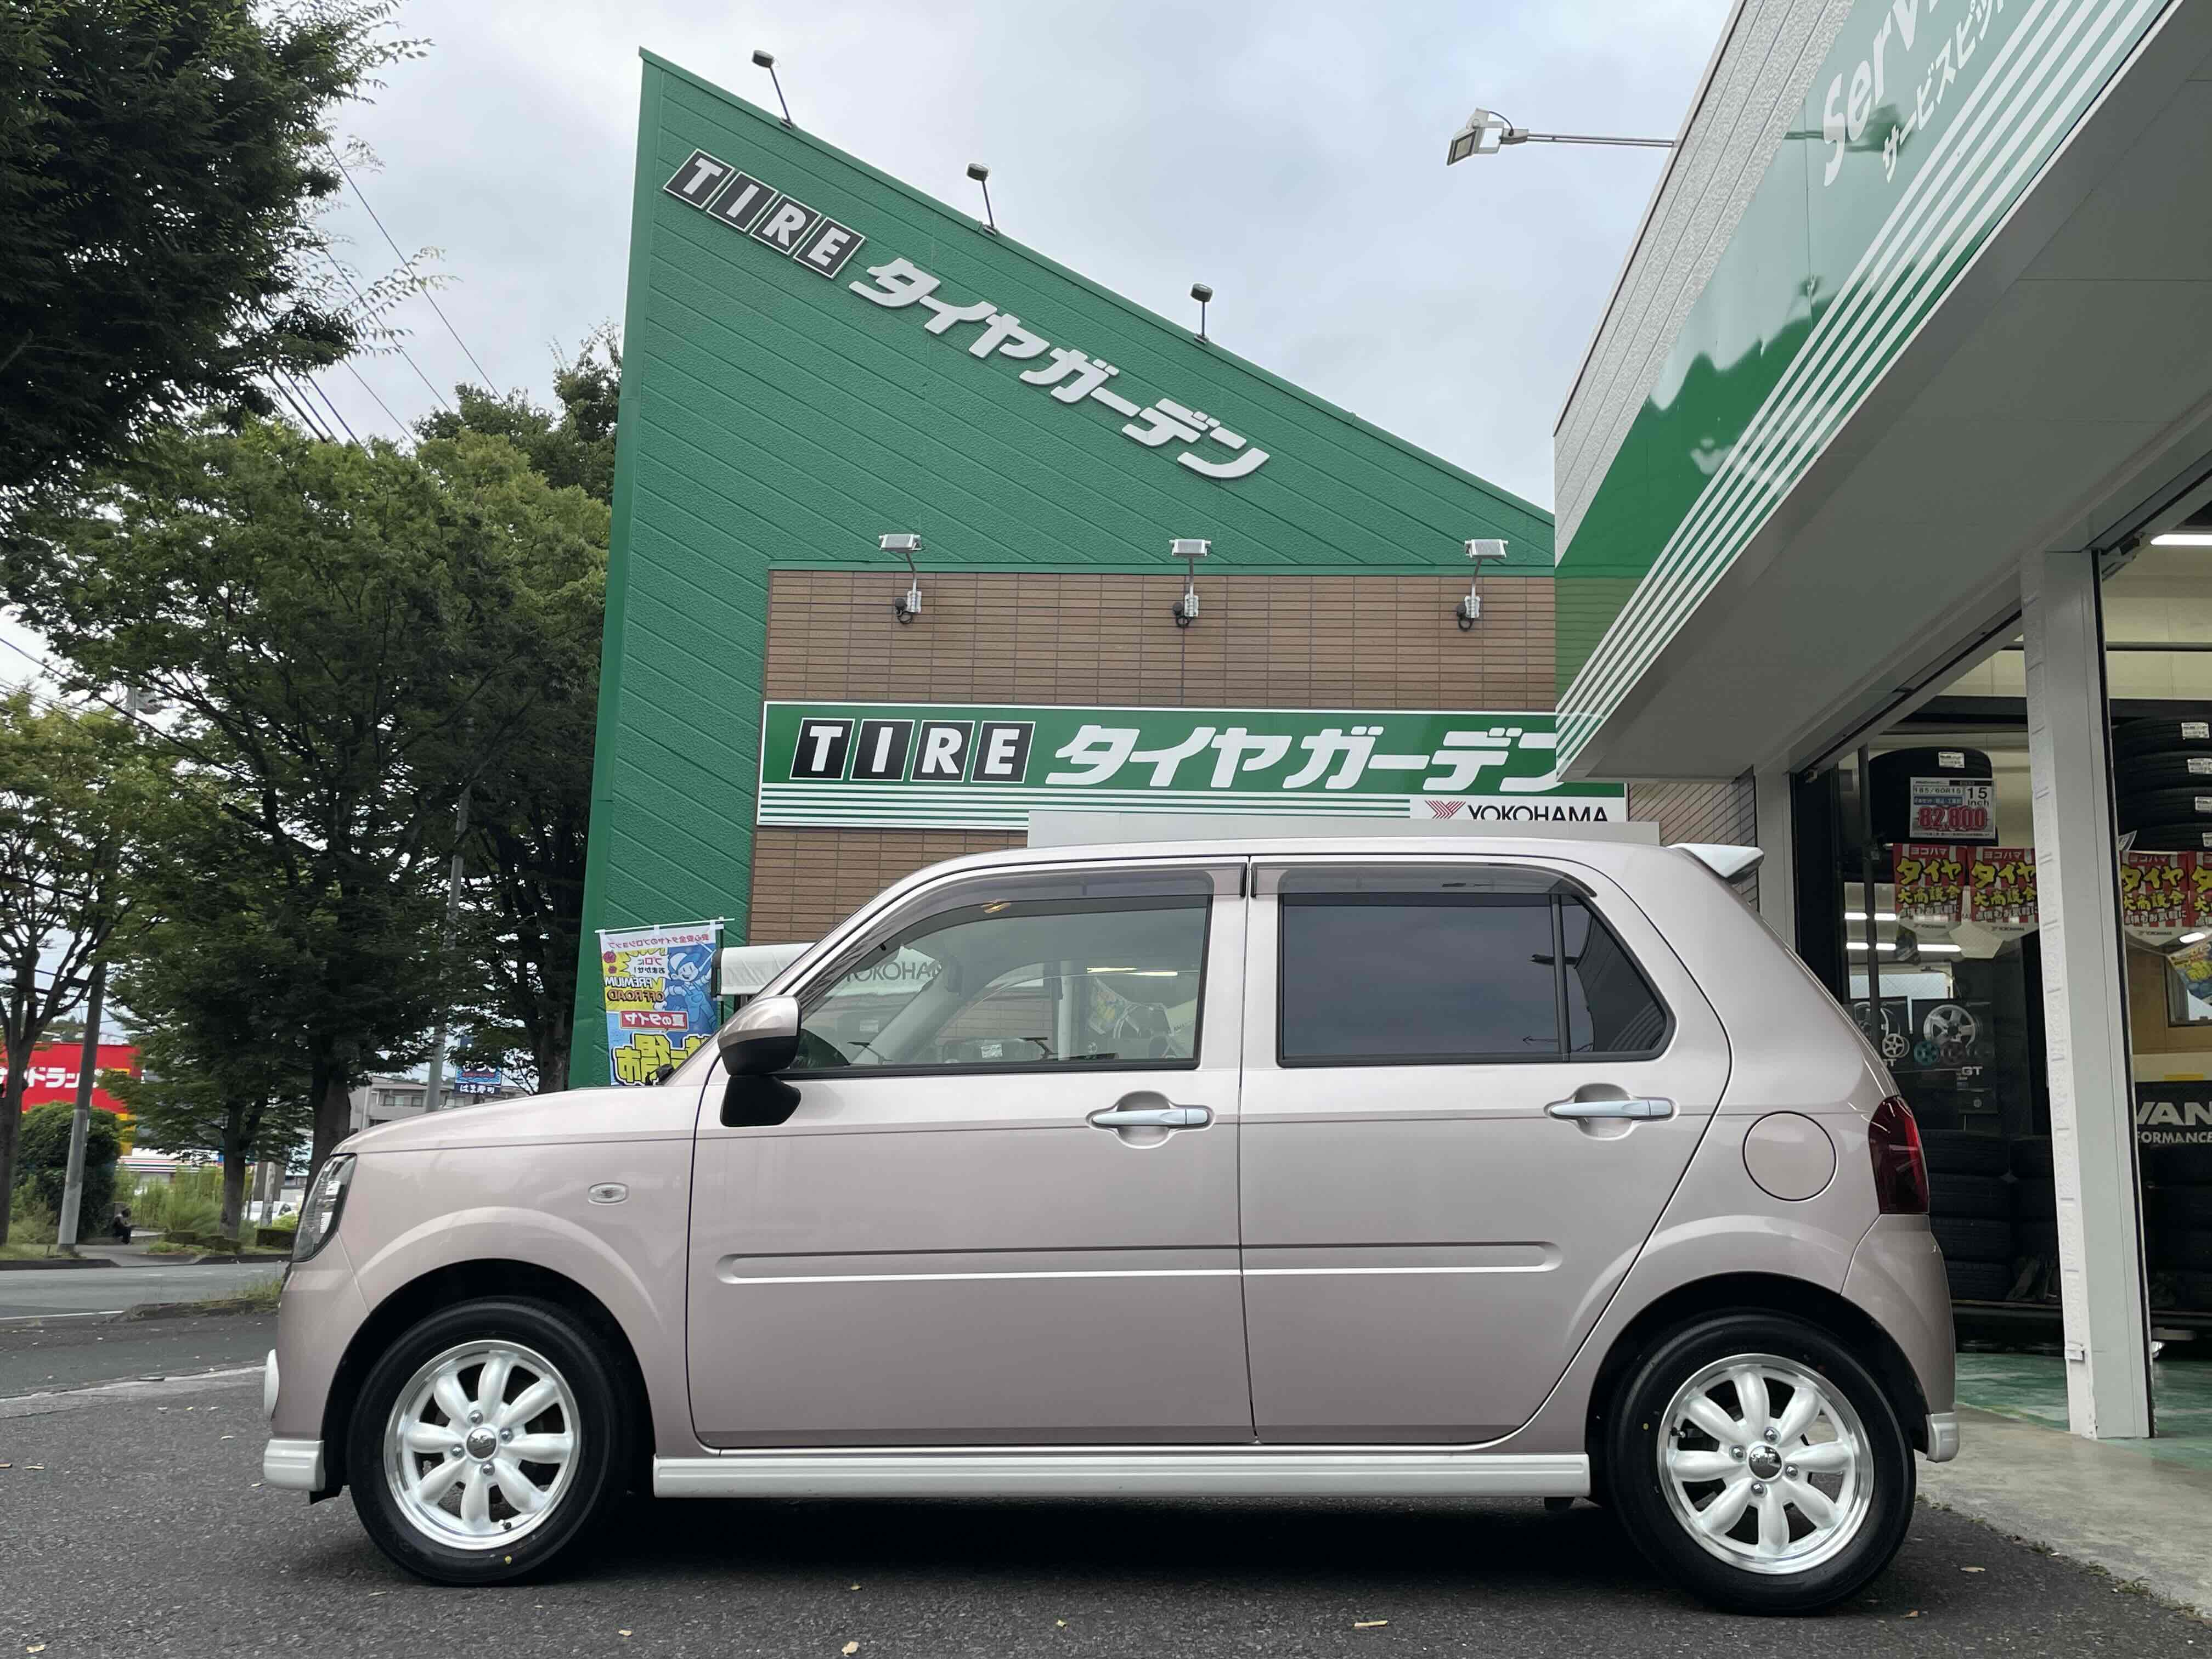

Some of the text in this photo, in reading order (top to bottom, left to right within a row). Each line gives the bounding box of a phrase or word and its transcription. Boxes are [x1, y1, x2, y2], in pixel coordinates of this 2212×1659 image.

[1824, 0, 1940, 187] Serv
[1882, 0, 2004, 184] サービスピッ
[682, 157, 856, 267] TIRE
[848, 257, 1271, 479] タイヤガーデン
[808, 725, 1021, 775] TIRE
[1967, 787, 1988, 799] 15
[1468, 804, 1609, 822] YOKOHAMA
[1910, 847, 1948, 855] ヨコハマ
[1983, 850, 2022, 859] ヨコハマ
[1896, 856, 1962, 885] タイヤ
[1971, 860, 2036, 889] タイヤ
[2121, 864, 2185, 893] タイヤ
[460, 1084, 495, 1094] はま寿司
